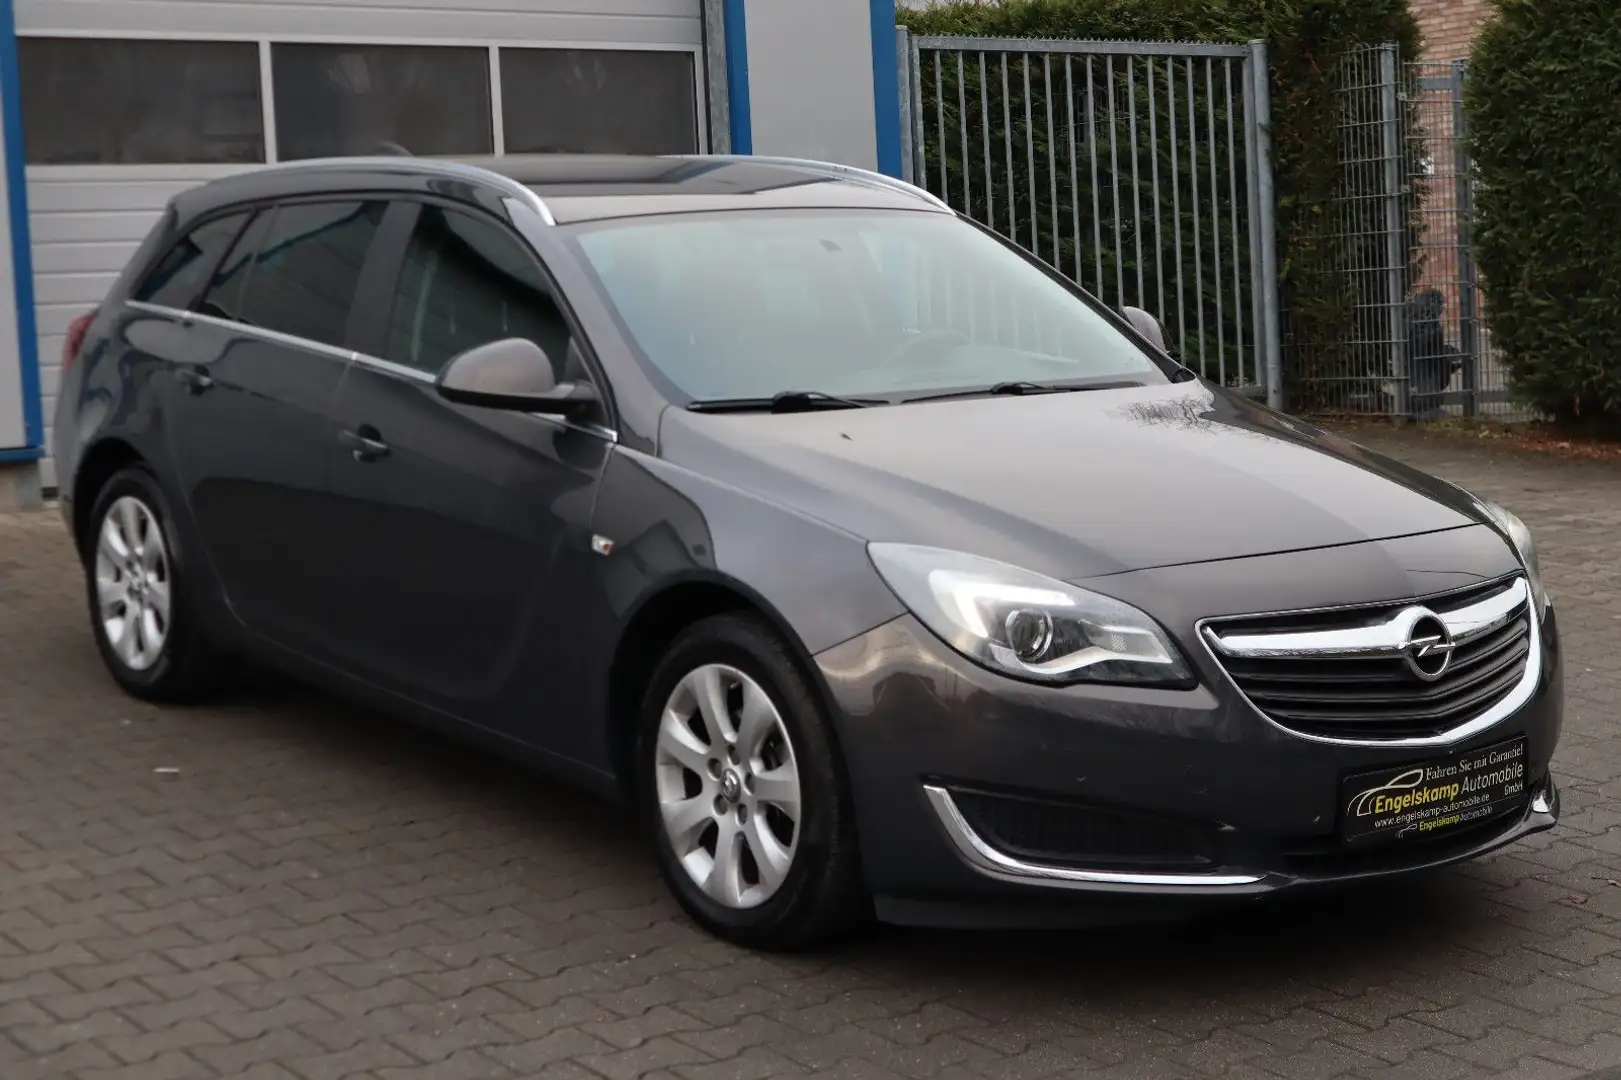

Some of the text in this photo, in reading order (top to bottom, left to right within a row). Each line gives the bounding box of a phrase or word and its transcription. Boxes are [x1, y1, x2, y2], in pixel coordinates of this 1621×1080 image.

[1426, 743, 1523, 781] Fahren Sie mit Garantie!
[1375, 762, 1523, 814] Engelskamp Automobile
[1504, 780, 1523, 796] GmbH
[1374, 793, 1490, 828] www.engelskamp-automobile.de
